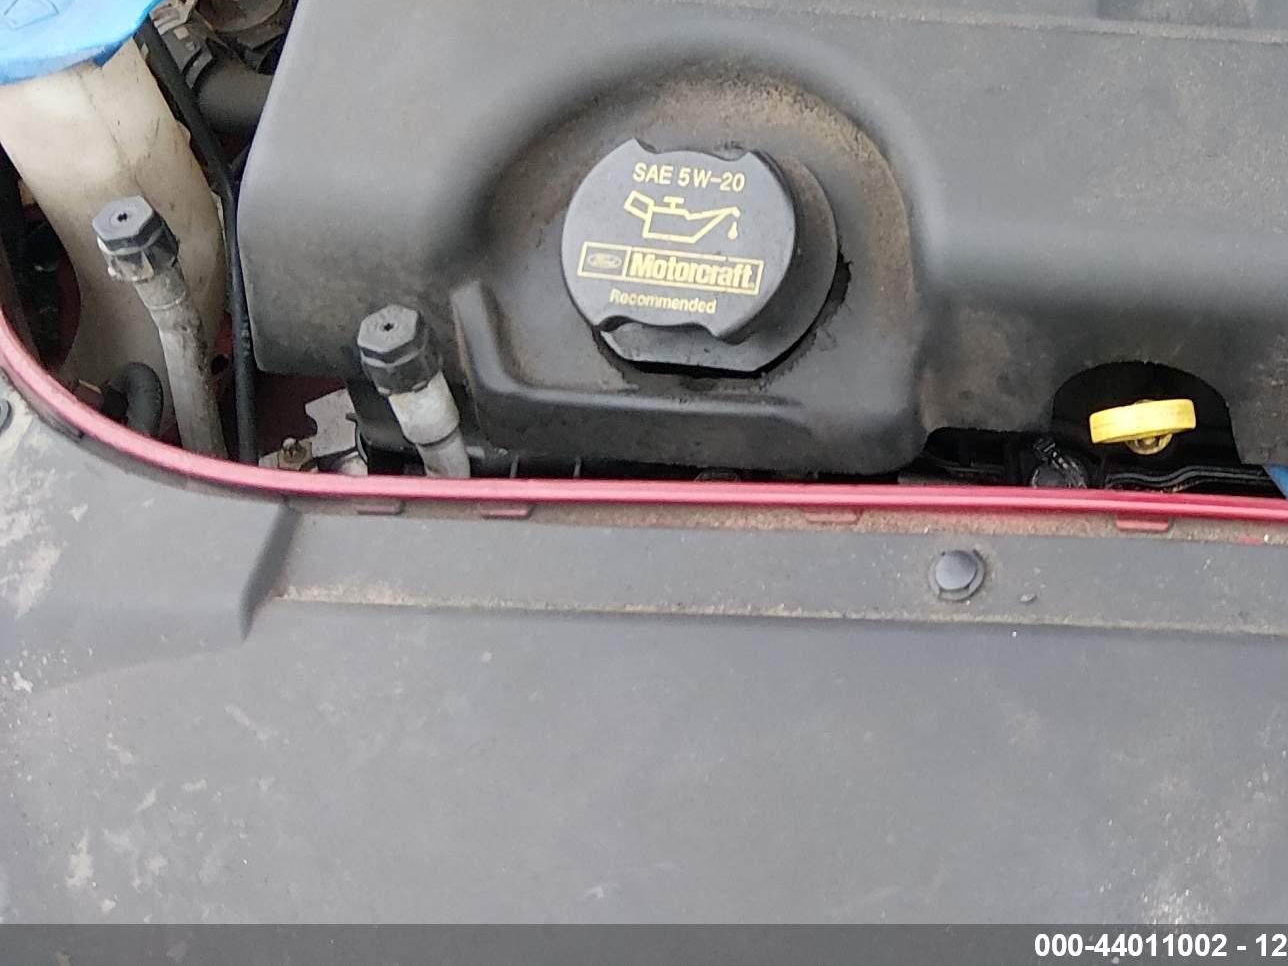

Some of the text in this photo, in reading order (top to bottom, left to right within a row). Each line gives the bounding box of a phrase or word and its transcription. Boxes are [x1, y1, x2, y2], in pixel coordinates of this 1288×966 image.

[632, 162, 745, 192] SAE 5W-20
[609, 288, 717, 315] Recommended
